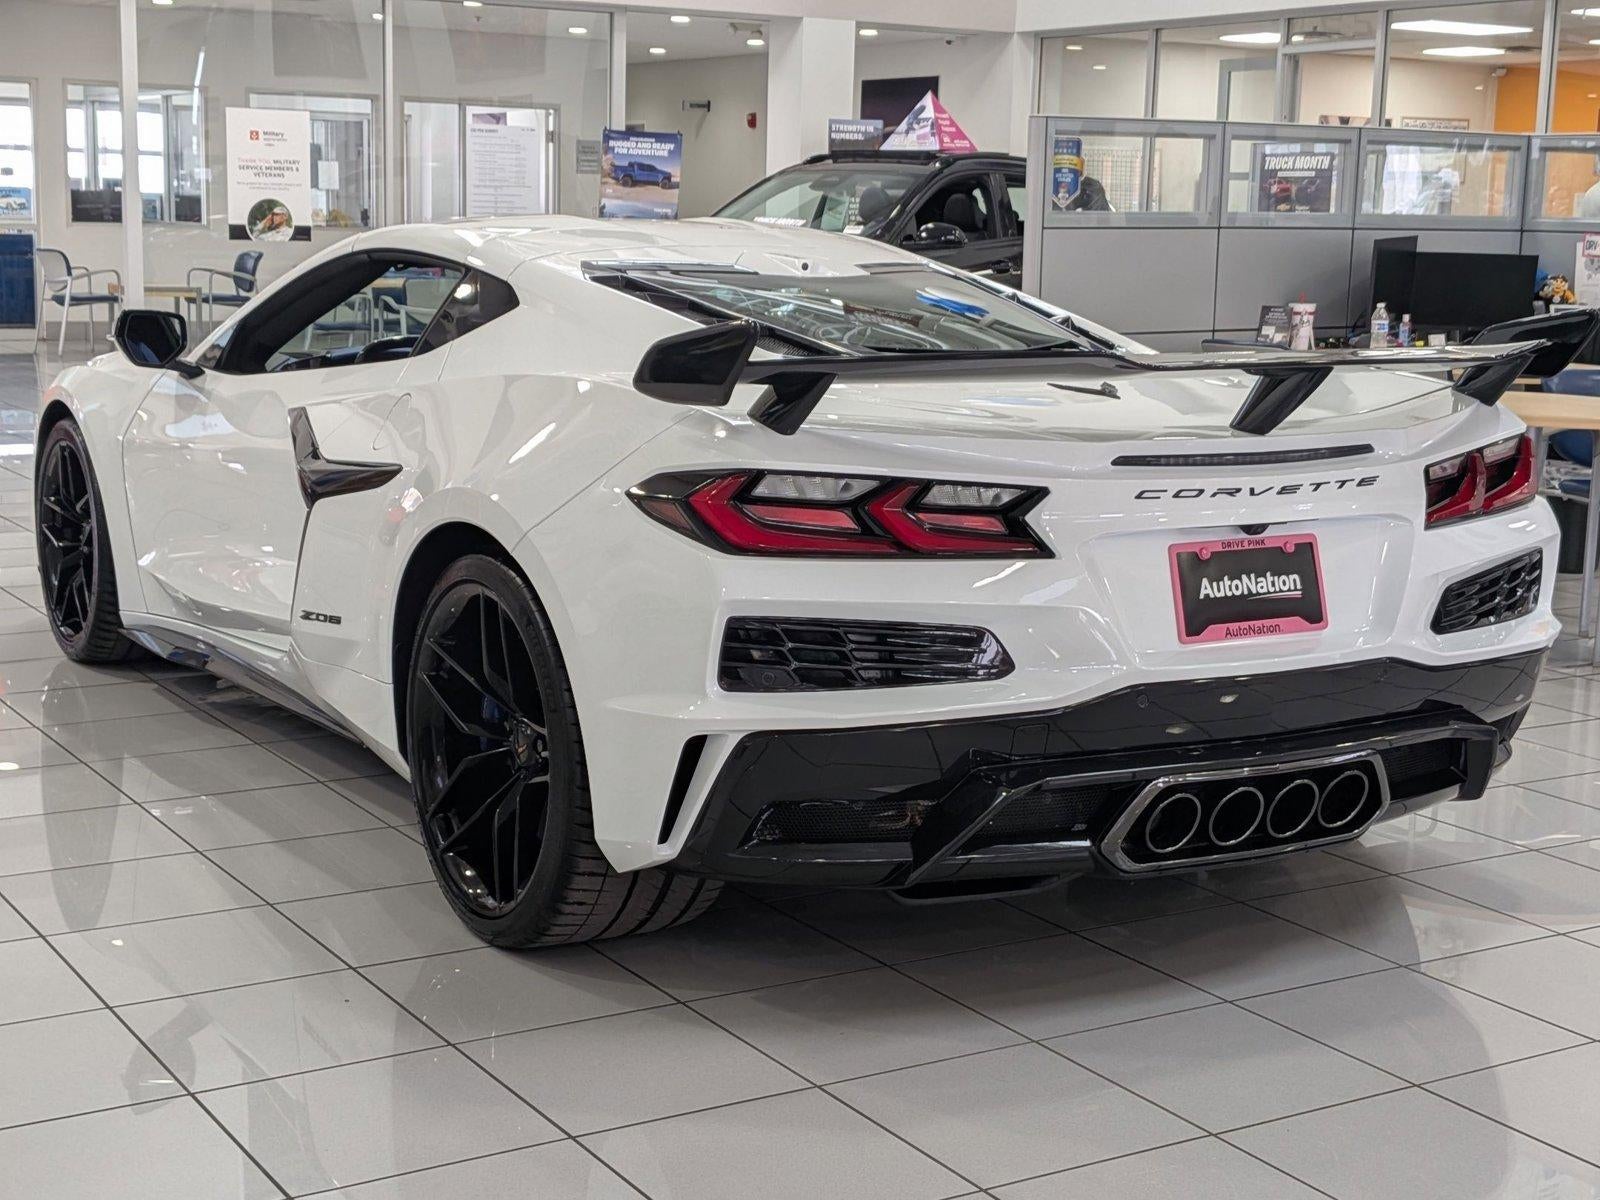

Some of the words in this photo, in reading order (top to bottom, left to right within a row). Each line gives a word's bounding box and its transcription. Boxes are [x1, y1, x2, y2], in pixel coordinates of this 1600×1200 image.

[608, 140, 635, 149] RUGGED
[628, 149, 668, 157] ADVENTURE
[1265, 156, 1295, 169] TRUCK
[1295, 155, 1330, 169] MONTH
[1134, 475, 1380, 500] CORVETTE
[1221, 540, 1245, 549] DRIVE
[1247, 538, 1266, 547] PINK
[1199, 572, 1303, 600] AutoNation
[299, 609, 342, 625] Z06
